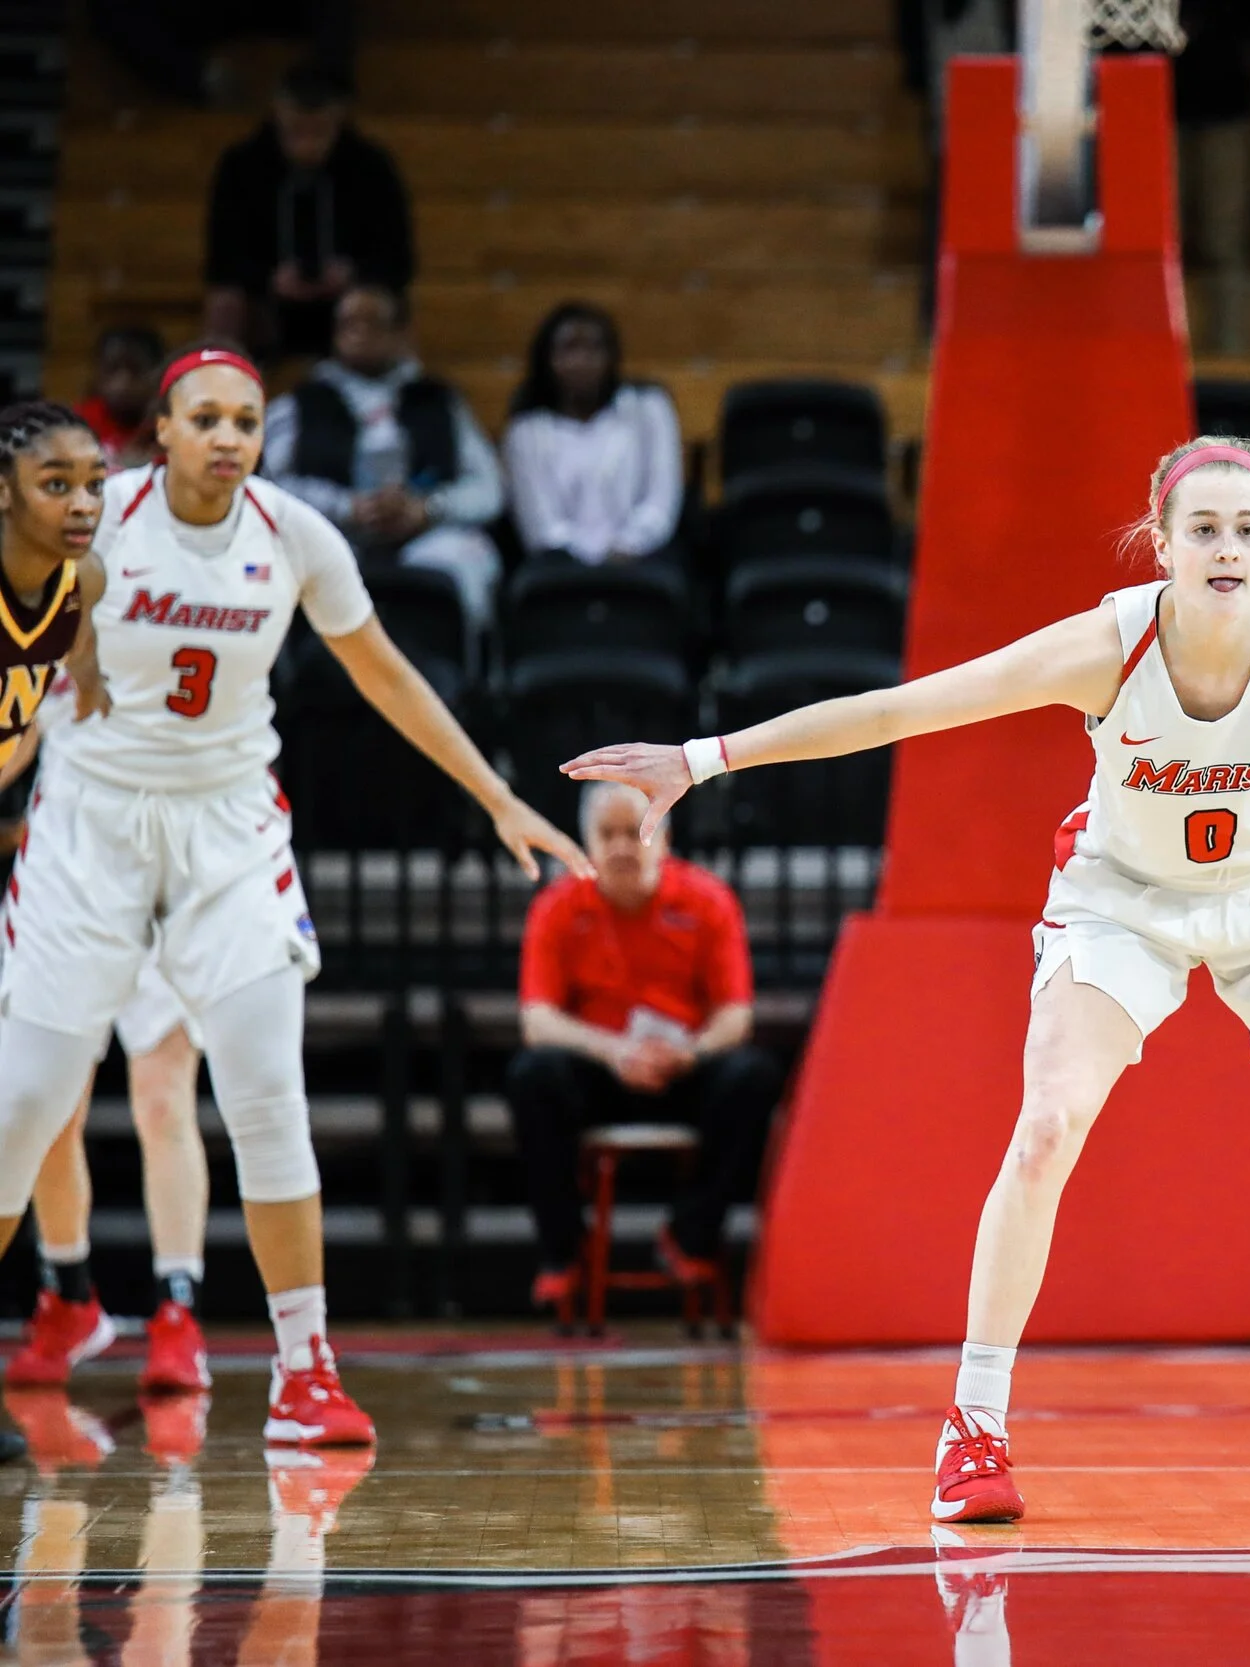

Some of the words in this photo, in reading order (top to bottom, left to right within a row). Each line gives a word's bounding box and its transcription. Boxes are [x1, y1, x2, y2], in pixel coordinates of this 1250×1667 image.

[121, 586, 271, 634] MARIST
[165, 646, 218, 719] 3
[1184, 808, 1238, 864] 0
